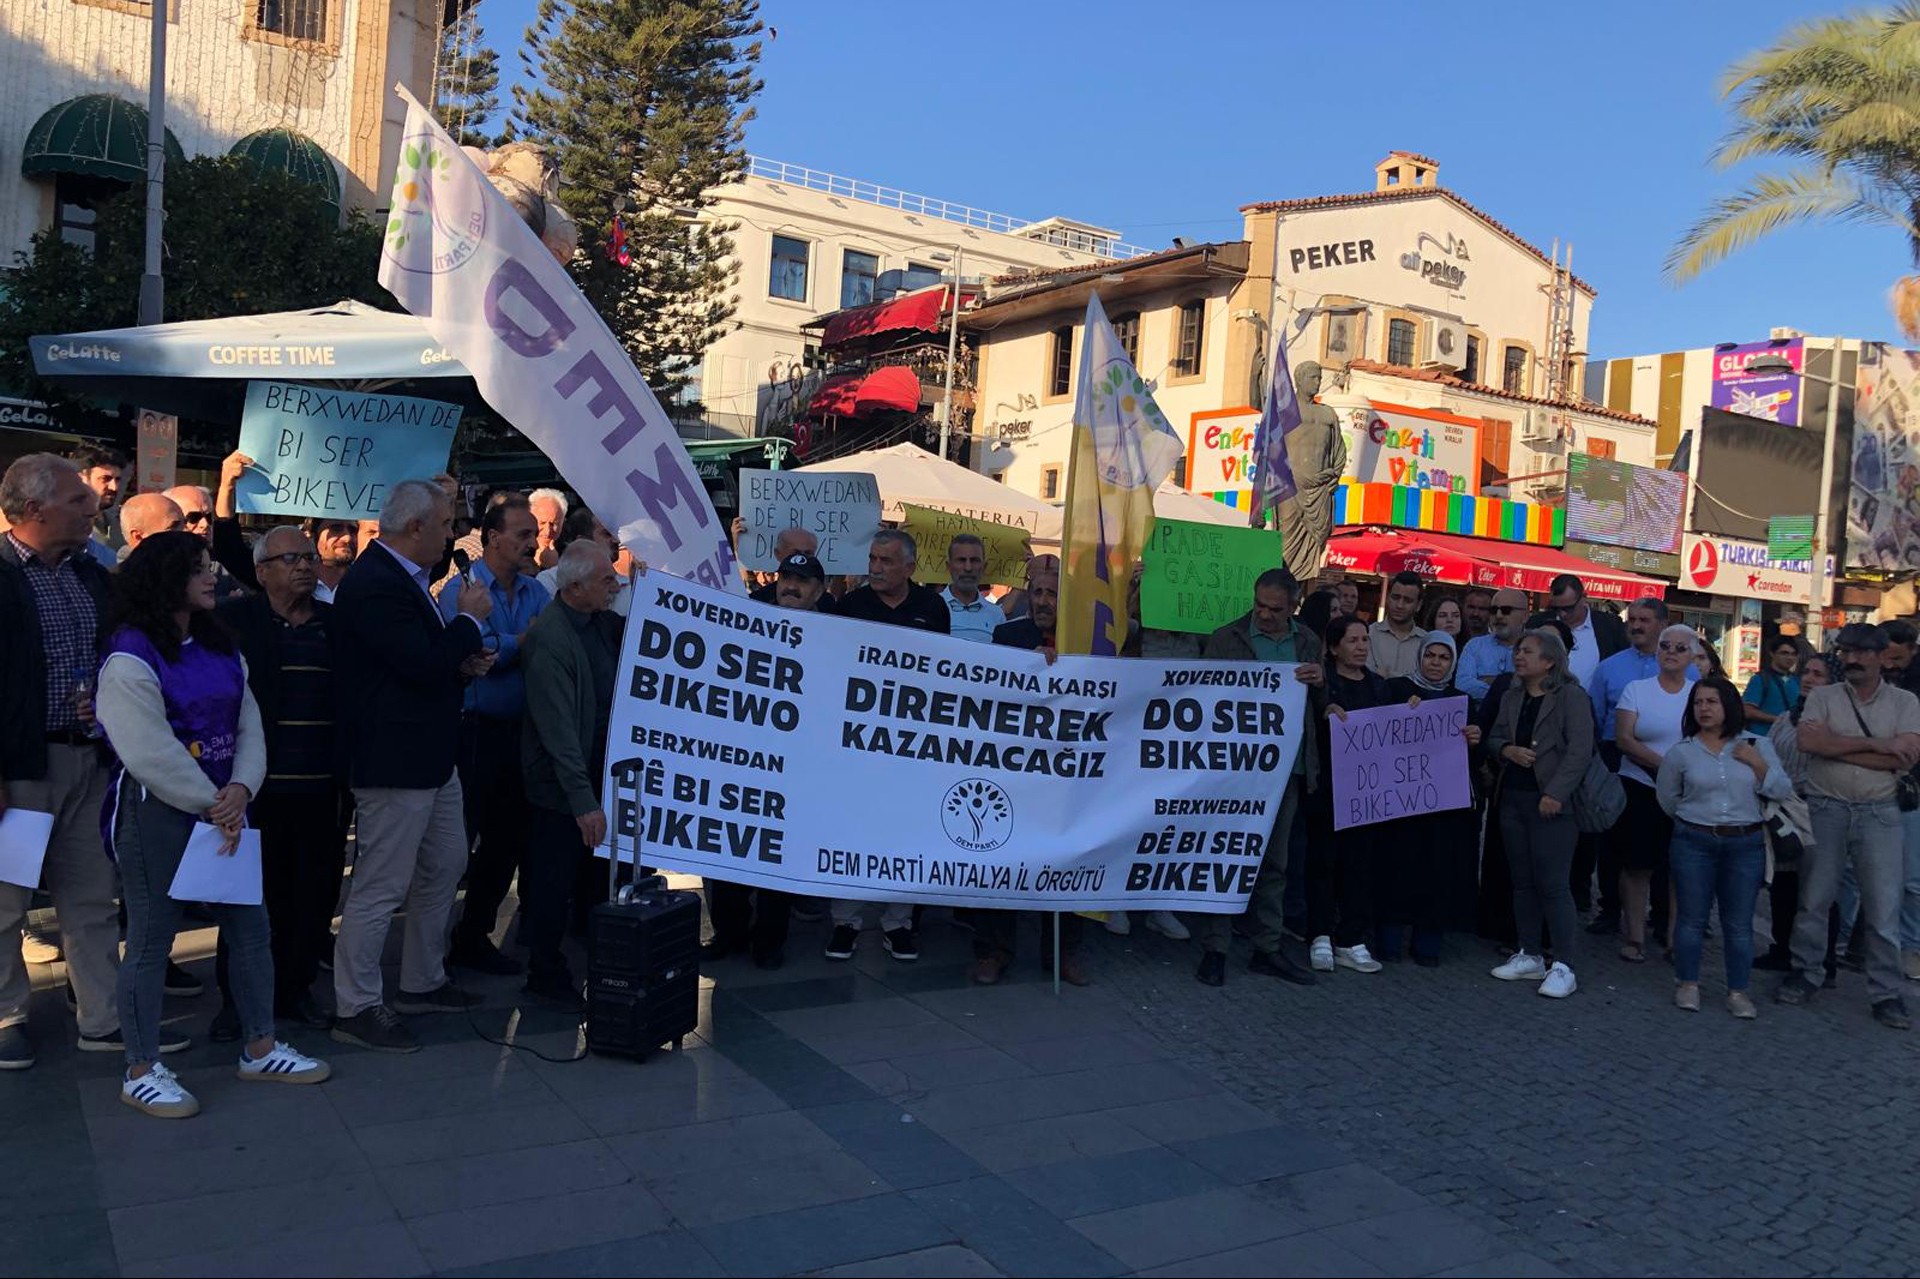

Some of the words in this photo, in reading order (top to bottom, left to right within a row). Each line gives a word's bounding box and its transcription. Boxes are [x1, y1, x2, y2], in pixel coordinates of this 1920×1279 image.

[1290, 239, 1376, 274] PEKER
[1421, 258, 1467, 287] peker
[208, 346, 282, 366] COFFEE
[285, 346, 335, 366] TIME
[266, 385, 426, 426] BERXWEDAN
[278, 429, 304, 459] BI
[319, 435, 374, 467] SER
[274, 474, 385, 513] BIKEVE
[751, 478, 872, 503] BERXWEDAN
[755, 503, 777, 529] DÊ
[814, 511, 849, 533] SER
[655, 587, 804, 649] XOVERDAYÎŞ
[637, 618, 706, 670] DO
[717, 642, 804, 695] SER
[630, 665, 800, 732] BIKEWO
[937, 659, 1041, 693] GASPINA
[1048, 677, 1117, 700] KARŞI
[1162, 667, 1281, 693] XOVERDAYÎŞ
[1143, 697, 1203, 733] DO
[1212, 699, 1285, 736] SER
[631, 725, 784, 773] BERXWEDAN
[841, 721, 1106, 779] KAZANACAĞIZ
[1140, 739, 1280, 772] BIKEWO
[618, 758, 665, 797] DÊ
[673, 773, 711, 806] BI
[719, 783, 786, 820] SER
[1357, 762, 1379, 791] DO
[1393, 754, 1432, 784] SER
[1154, 798, 1266, 816] BERXWEDAN
[1350, 783, 1438, 824] BIKEWO
[617, 798, 785, 865] BIKEVE
[955, 836, 974, 849] DEM
[1136, 825, 1176, 855] DÊ
[1177, 831, 1207, 854] BI
[1210, 832, 1264, 857] SER
[817, 848, 861, 877] DEM
[866, 854, 924, 883] PARTİ
[928, 860, 1011, 890] ANTALYA
[1014, 861, 1030, 891] İL
[1035, 864, 1106, 893] ÖRGÜTÜ
[1125, 863, 1260, 895] BIKEVE
